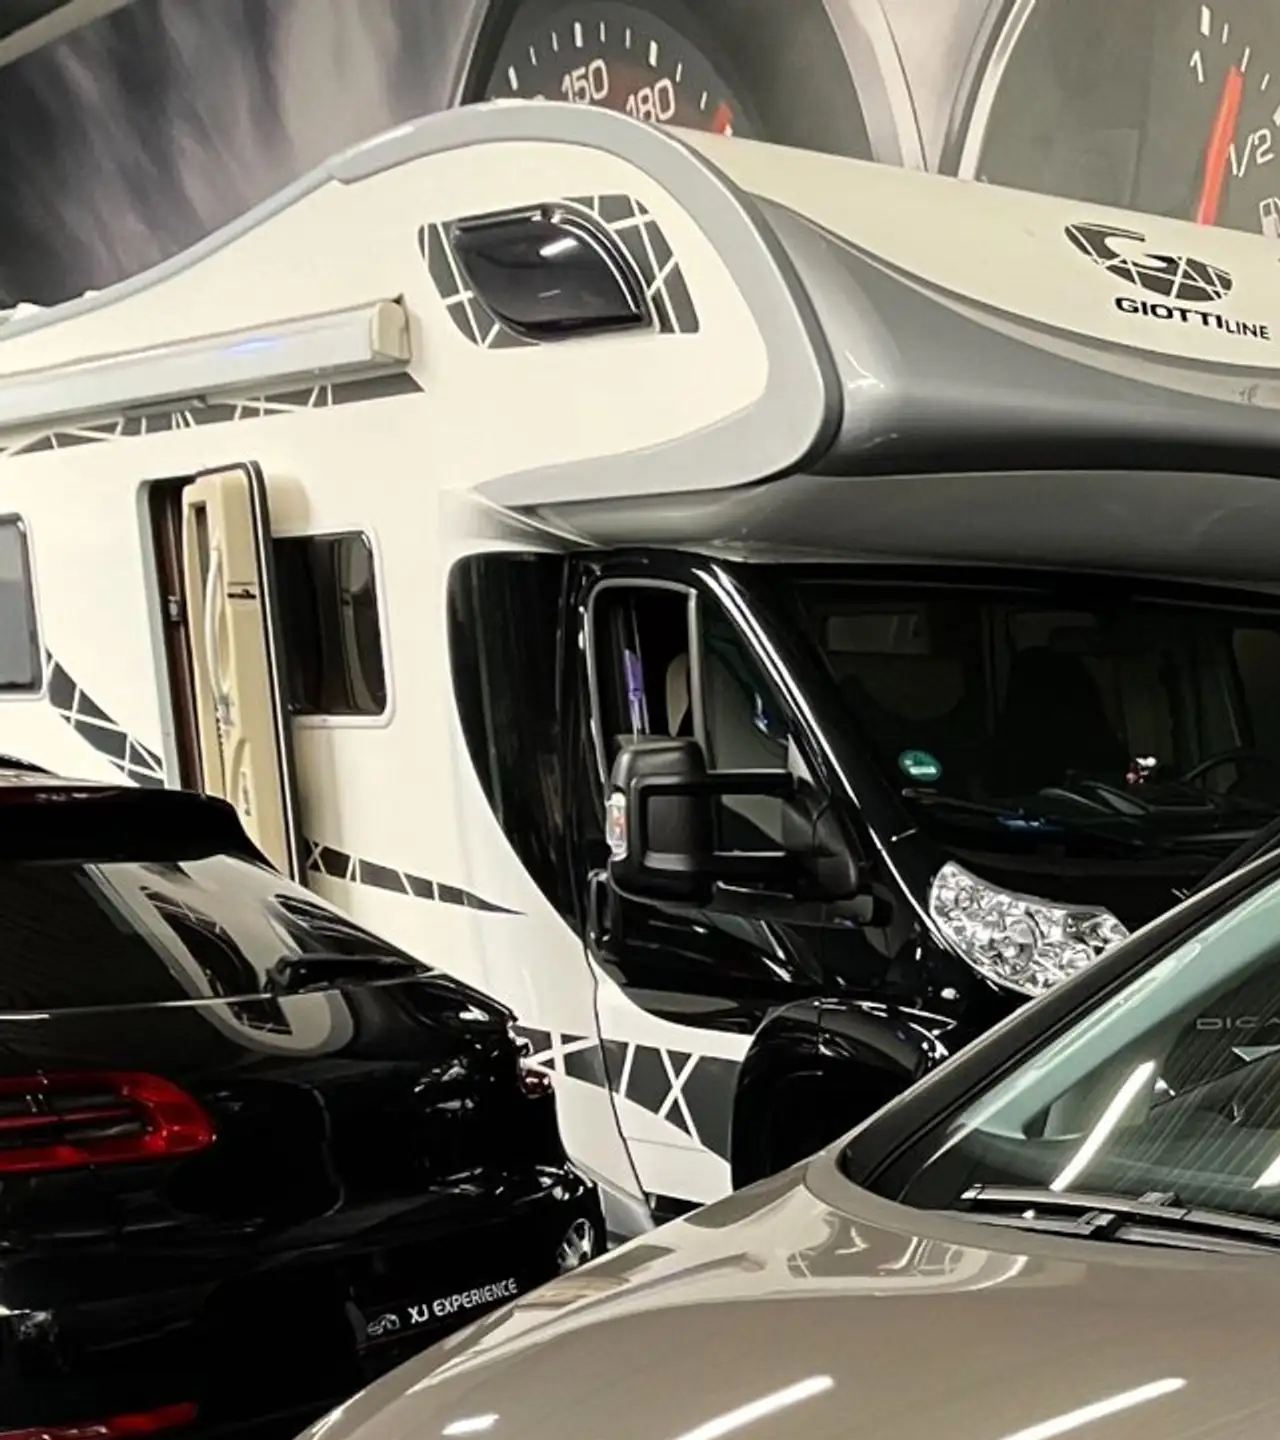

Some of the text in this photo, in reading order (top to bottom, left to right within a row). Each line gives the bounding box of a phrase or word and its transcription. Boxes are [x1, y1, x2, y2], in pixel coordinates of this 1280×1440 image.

[561, 57, 609, 104] 150
[626, 77, 676, 122] 180
[407, 1277, 518, 1324] XJ EXPERIENCE
